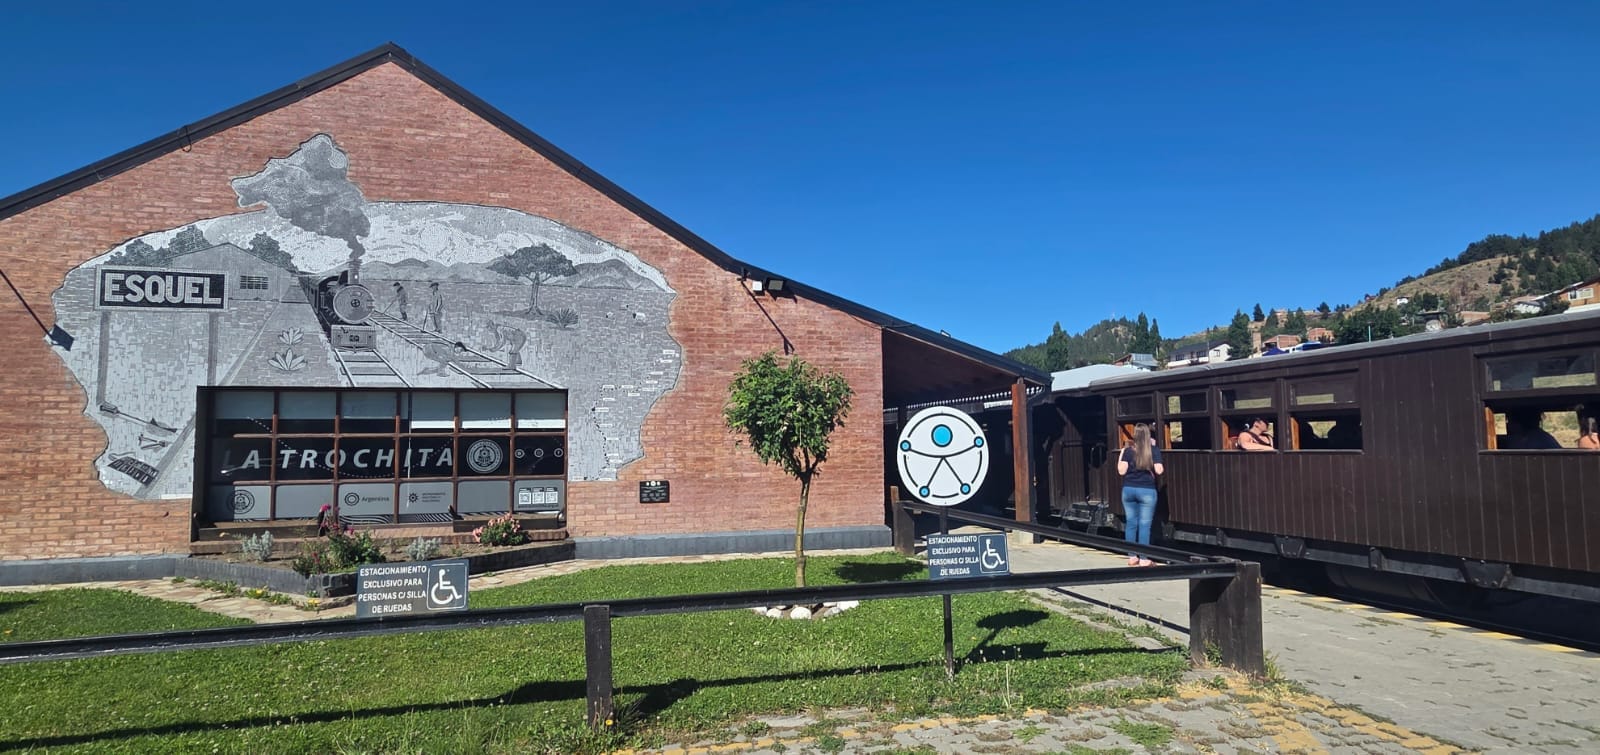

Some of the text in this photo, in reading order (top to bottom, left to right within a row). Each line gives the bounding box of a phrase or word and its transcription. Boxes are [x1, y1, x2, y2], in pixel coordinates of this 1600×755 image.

[104, 272, 222, 304] ESQUEL
[280, 448, 453, 469] TROCHITA
[928, 536, 977, 544] ESTACIONAMIENTO
[961, 546, 976, 554] PARA
[929, 557, 958, 566] PERSONAS
[965, 556, 980, 564] SILLA
[360, 565, 427, 576] ESTACIONAMIENTO
[949, 567, 971, 575] RUEDAS
[363, 578, 423, 589] EXCLUSIVO PARA
[358, 593, 397, 601] PERSONAS
[406, 590, 427, 598] SILLA
[372, 603, 412, 614] DE RUEDAS
